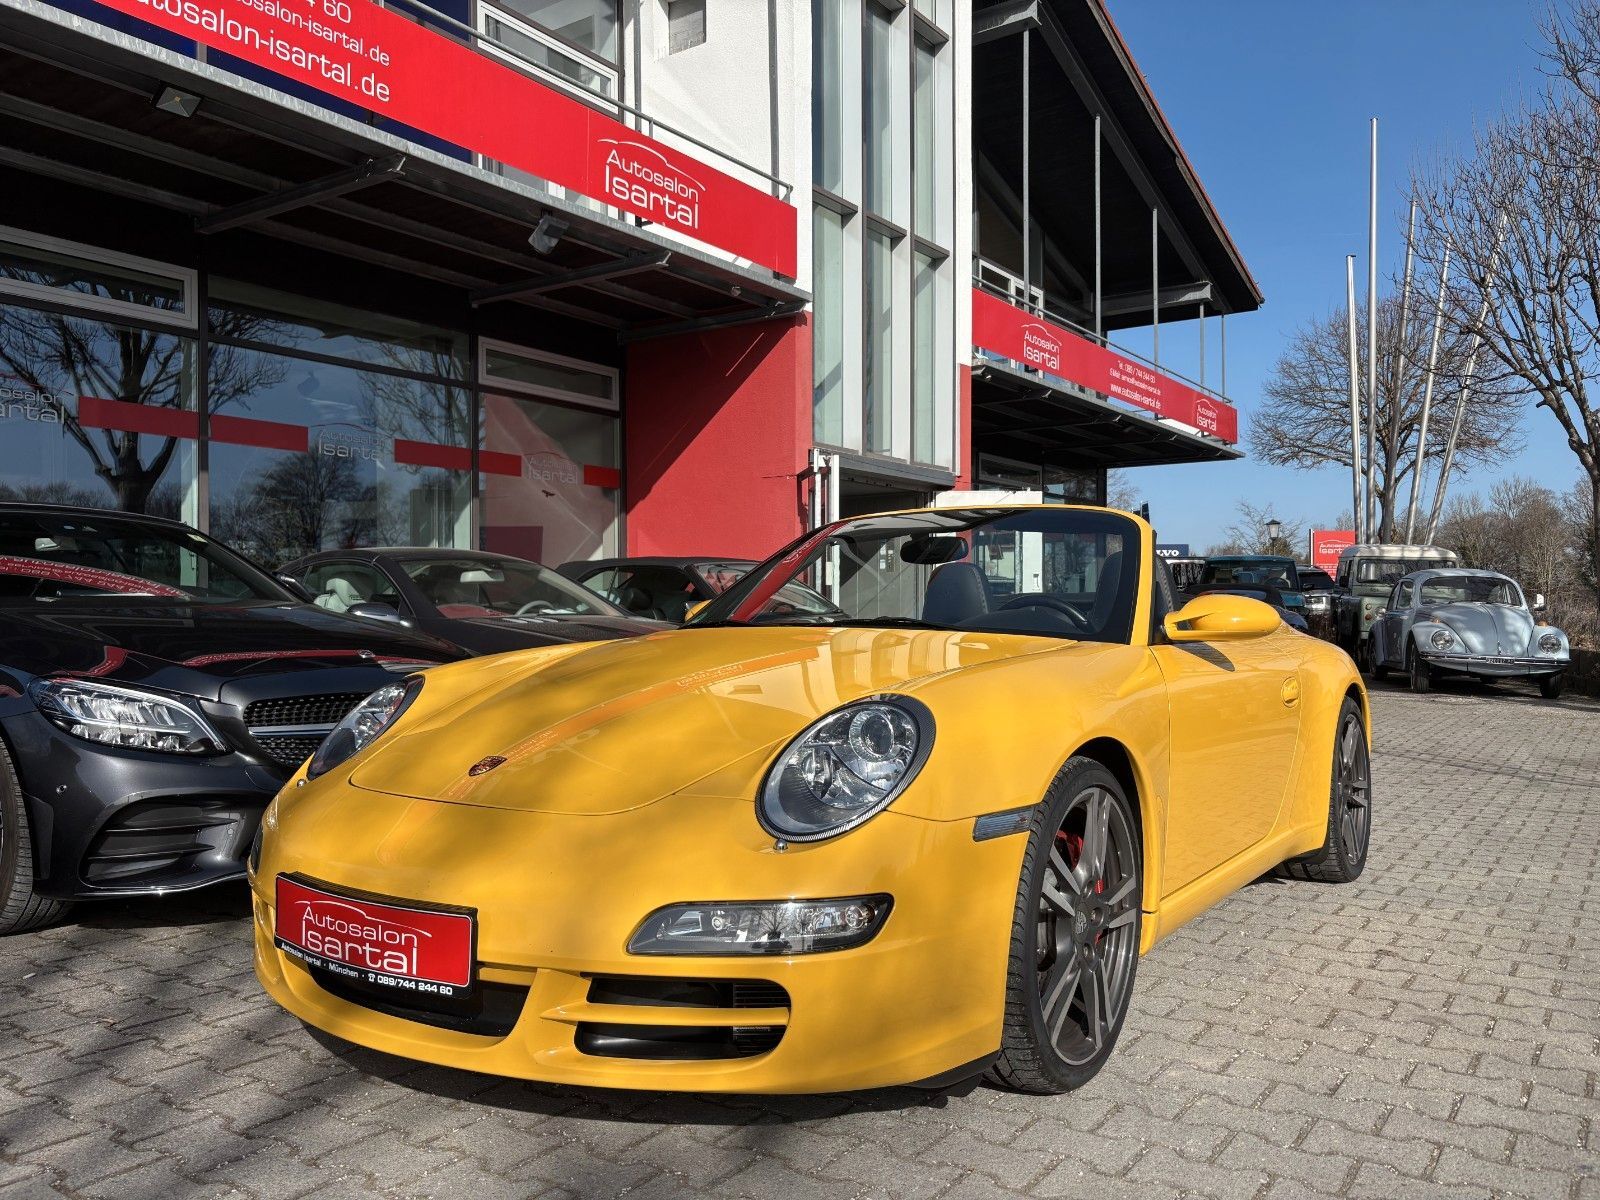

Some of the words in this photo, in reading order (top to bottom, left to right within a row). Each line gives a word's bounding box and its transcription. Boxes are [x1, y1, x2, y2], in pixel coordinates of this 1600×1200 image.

[323, 0, 351, 24] 60
[138, 0, 390, 102] osalon-isartal.de
[605, 165, 699, 229] Isartal
[606, 149, 699, 203] Autosalon
[1023, 340, 1060, 371] Isartal
[1024, 330, 1059, 353] Autosalon
[0, 388, 65, 404] osalon
[1196, 411, 1217, 431] Isartal
[301, 920, 417, 976] Isartal
[303, 906, 417, 948] Autosalon
[281, 941, 304, 958] Autosalon
[303, 954, 321, 967] Isartal
[328, 962, 359, 978] München
[377, 975, 415, 990] 089/744
[418, 982, 438, 993] 244
[439, 985, 453, 996] 60
